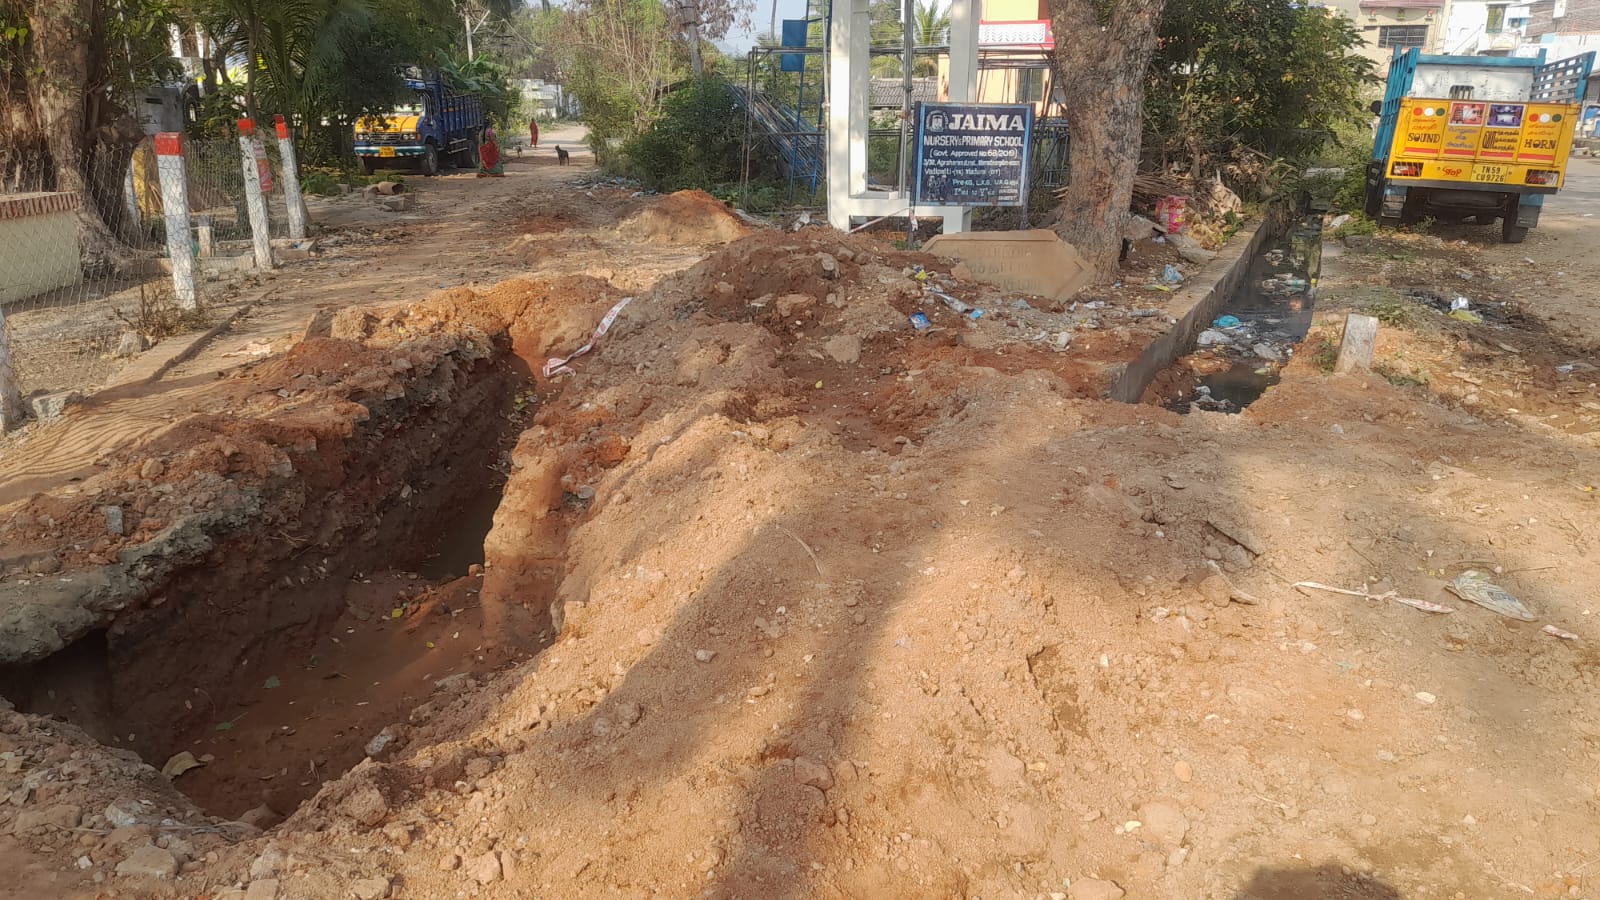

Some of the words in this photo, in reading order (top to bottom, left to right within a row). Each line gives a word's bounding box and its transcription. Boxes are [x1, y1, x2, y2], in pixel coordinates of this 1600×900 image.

[949, 114, 1024, 131] JAIMA
[924, 135, 958, 146] NURSERY
[962, 135, 992, 147] PRIMARY
[994, 136, 1023, 147] SCHOOL
[1408, 133, 1440, 143] SOUND
[1524, 138, 1557, 149] HORN
[950, 149, 978, 157] Approved
